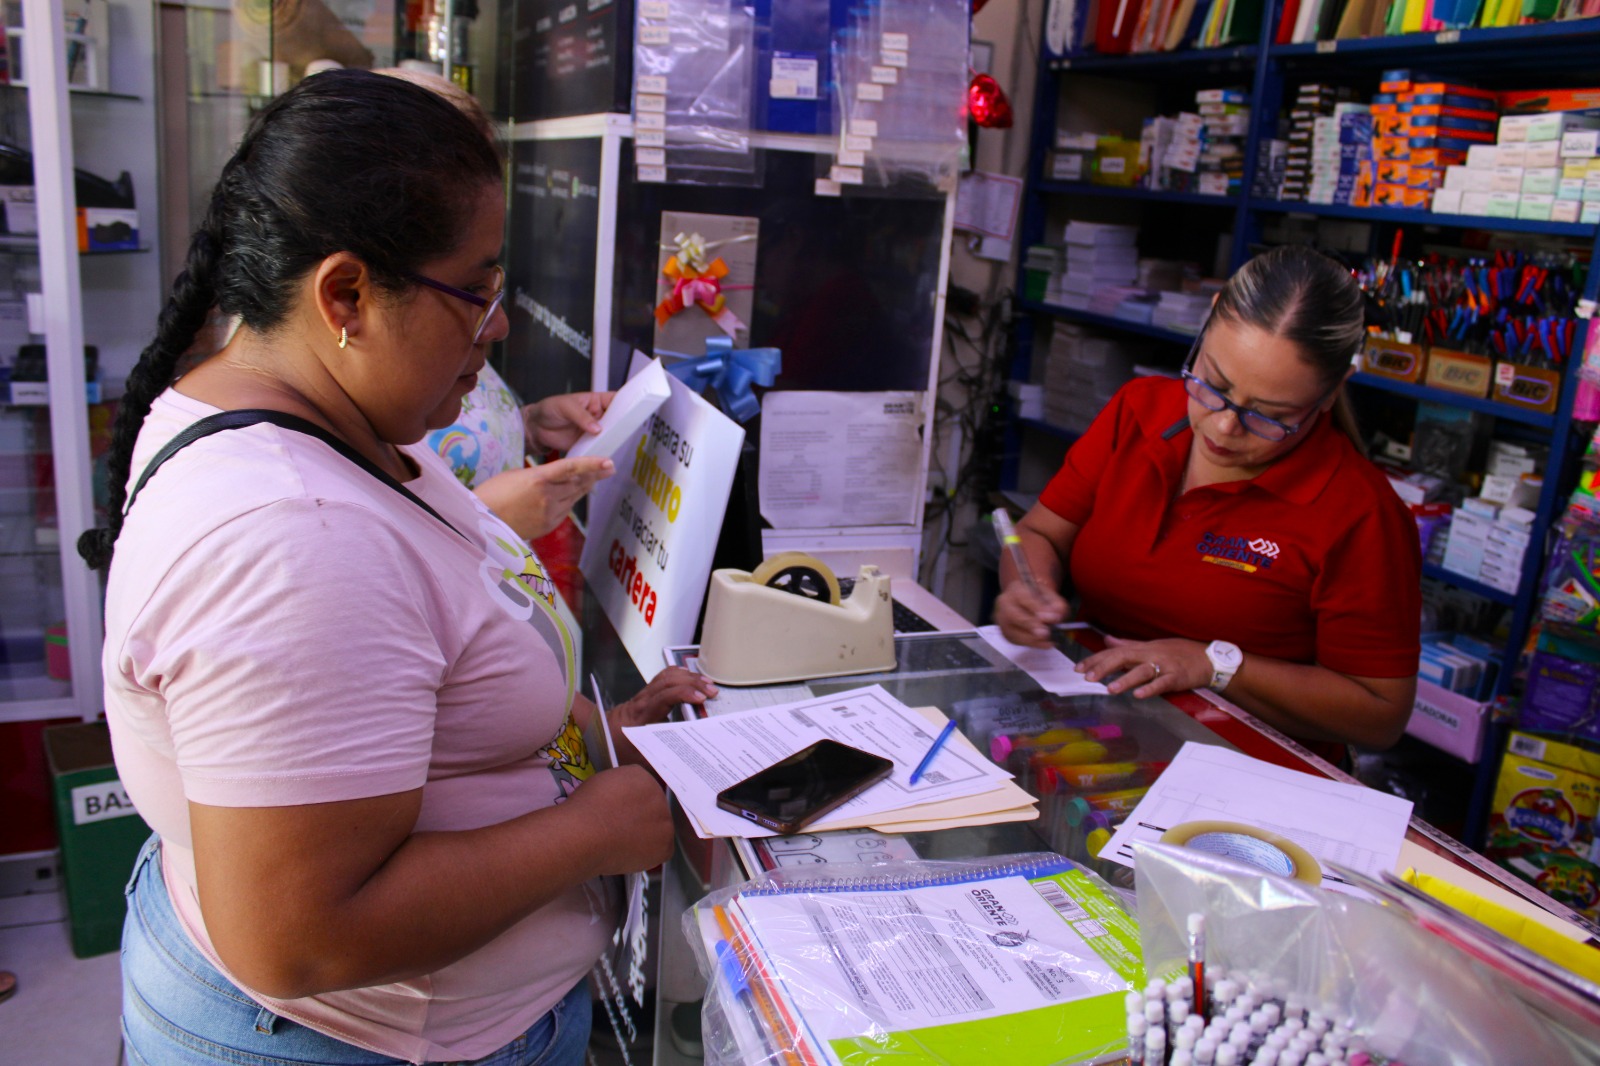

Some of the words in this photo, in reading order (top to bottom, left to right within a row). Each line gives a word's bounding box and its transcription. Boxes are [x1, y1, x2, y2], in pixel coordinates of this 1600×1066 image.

[1443, 365, 1481, 386] BIC
[1510, 381, 1548, 401] BIC
[643, 413, 679, 457] repara
[678, 439, 694, 469] su
[631, 434, 682, 524] futuro
[619, 495, 633, 525] sin
[631, 512, 659, 558] vaciar
[656, 540, 670, 572] tu
[1203, 532, 1249, 549] GRAN
[1196, 542, 1274, 570] ORIENTE
[608, 538, 658, 628] cartera
[971, 889, 1008, 927] ORIENTE
[980, 888, 1007, 914] GRAN
[1047, 968, 1057, 978] No.
